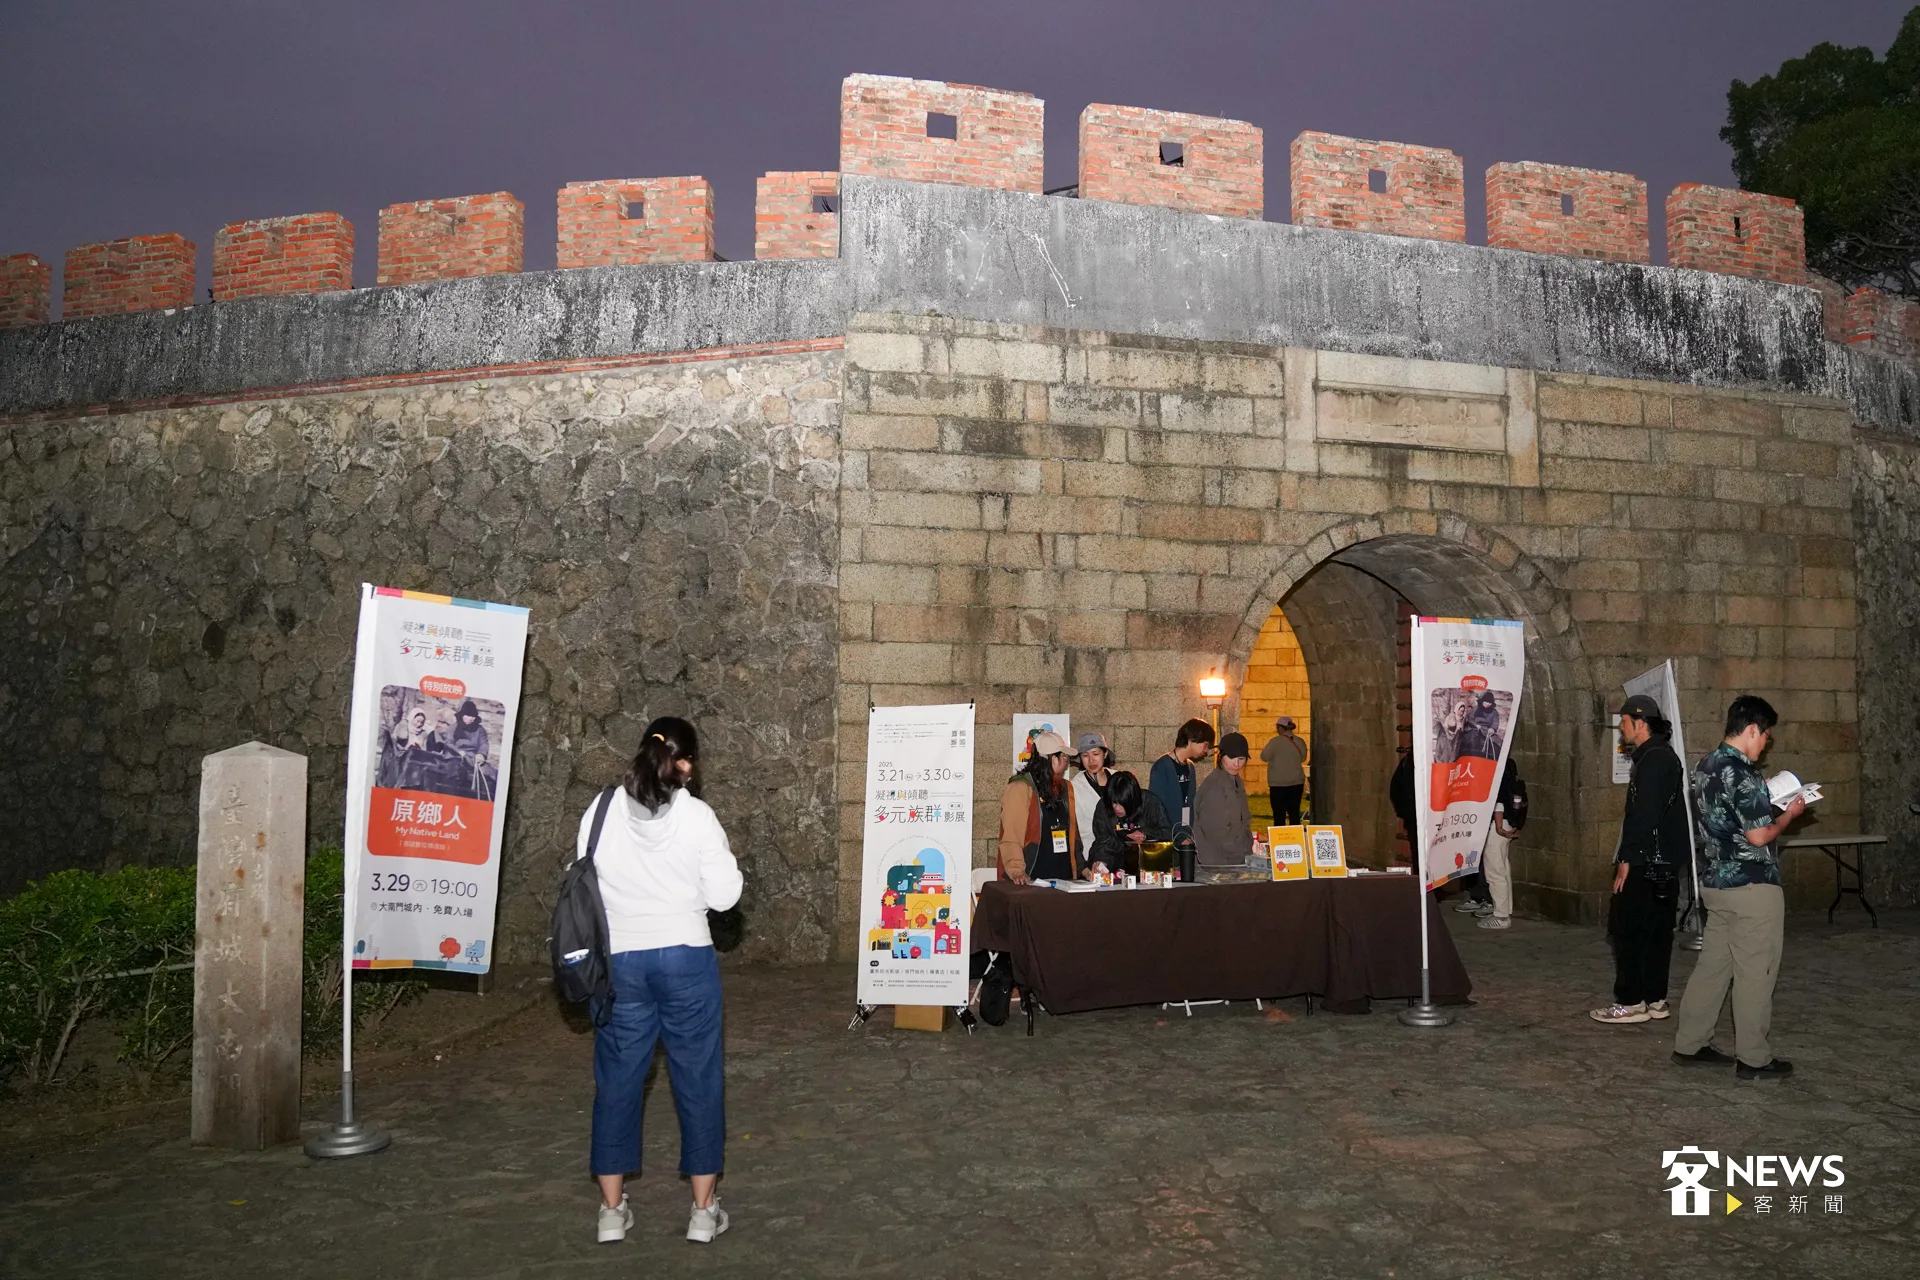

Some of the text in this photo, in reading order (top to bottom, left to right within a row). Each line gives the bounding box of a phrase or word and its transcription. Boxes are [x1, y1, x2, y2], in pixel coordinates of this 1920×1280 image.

[400, 621, 463, 641] 凝視與傾聽
[399, 637, 495, 668] 多元族群 影展
[1442, 650, 1491, 667] 多元族群
[423, 680, 464, 695] 特別放映
[877, 769, 904, 782] 3.21
[922, 768, 951, 781] 3.30
[874, 789, 929, 801] 凝視與傾聽
[390, 798, 467, 830] 原鄉人
[873, 803, 966, 824] 多元族群 影展
[1451, 813, 1478, 826] 19:00
[395, 826, 460, 841] My Native Land
[1276, 848, 1301, 859] 服務台
[371, 873, 410, 892] 3.29
[430, 878, 478, 898] 19:00
[378, 901, 473, 918] 大南門城內 免費入場
